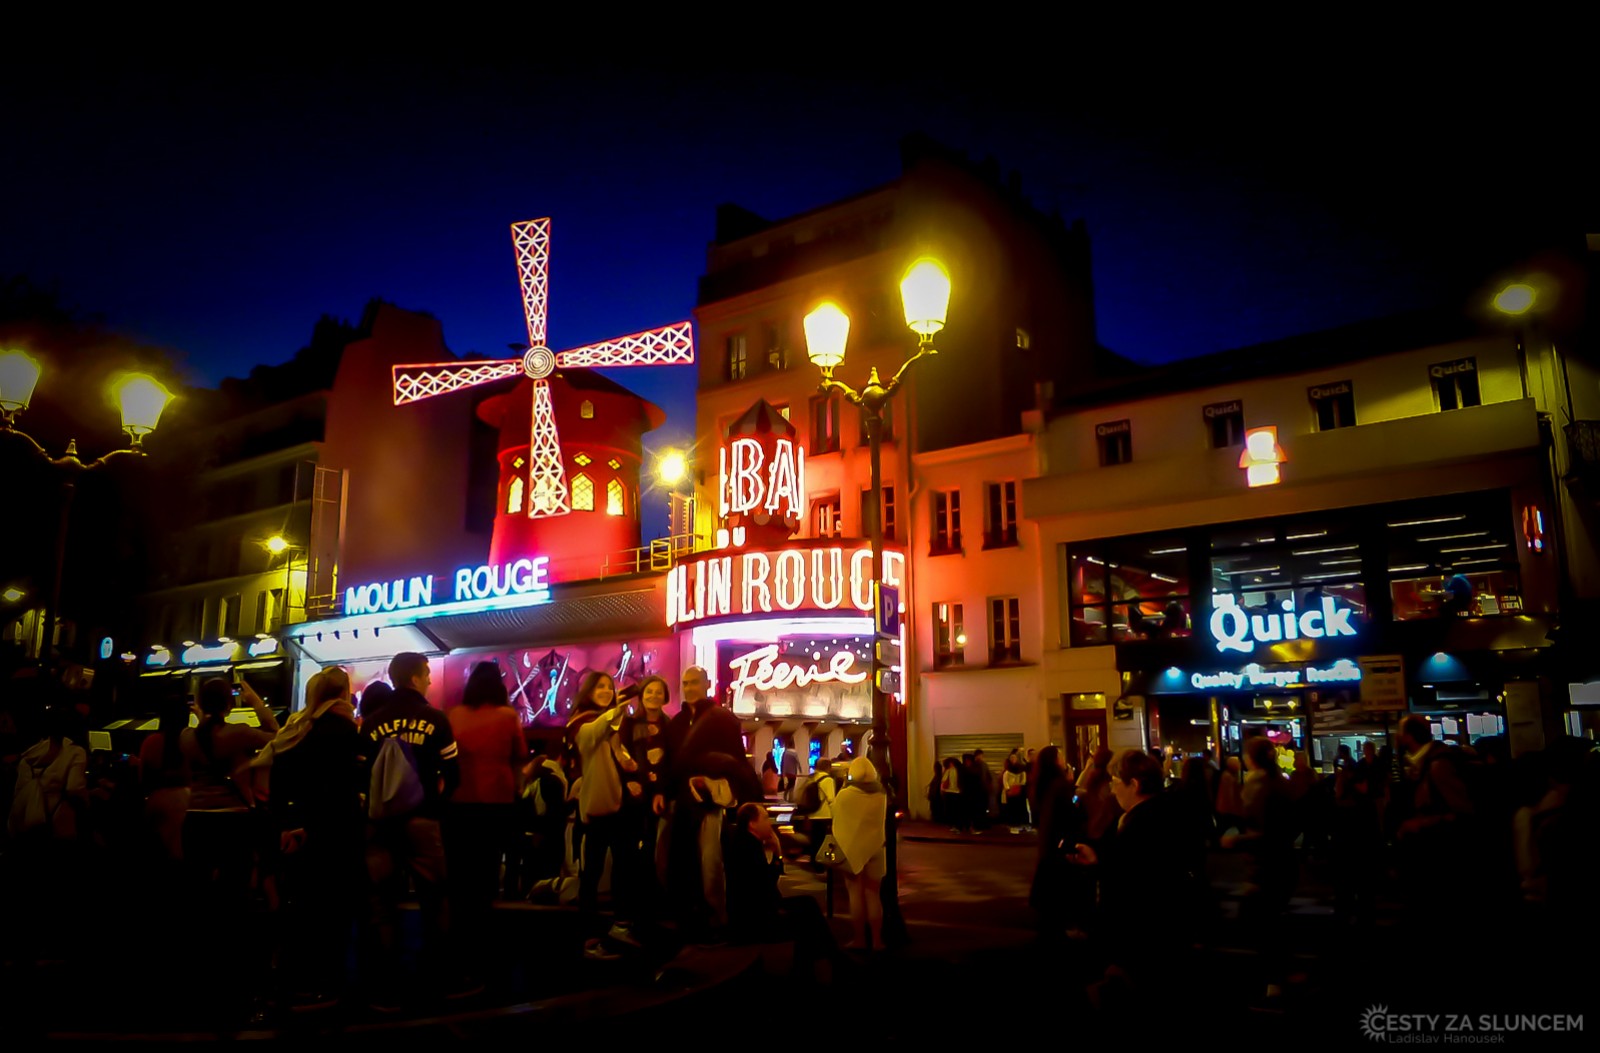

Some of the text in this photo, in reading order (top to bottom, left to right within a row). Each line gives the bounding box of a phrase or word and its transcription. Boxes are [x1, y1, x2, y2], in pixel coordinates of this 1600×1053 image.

[1430, 360, 1475, 379] Quick
[1309, 383, 1351, 400] Quick
[1204, 402, 1241, 418] Quick
[1096, 421, 1129, 436] Quick
[344, 556, 550, 616] MOULIN ROUGE
[884, 594, 894, 627] P
[1209, 594, 1358, 653] Quick
